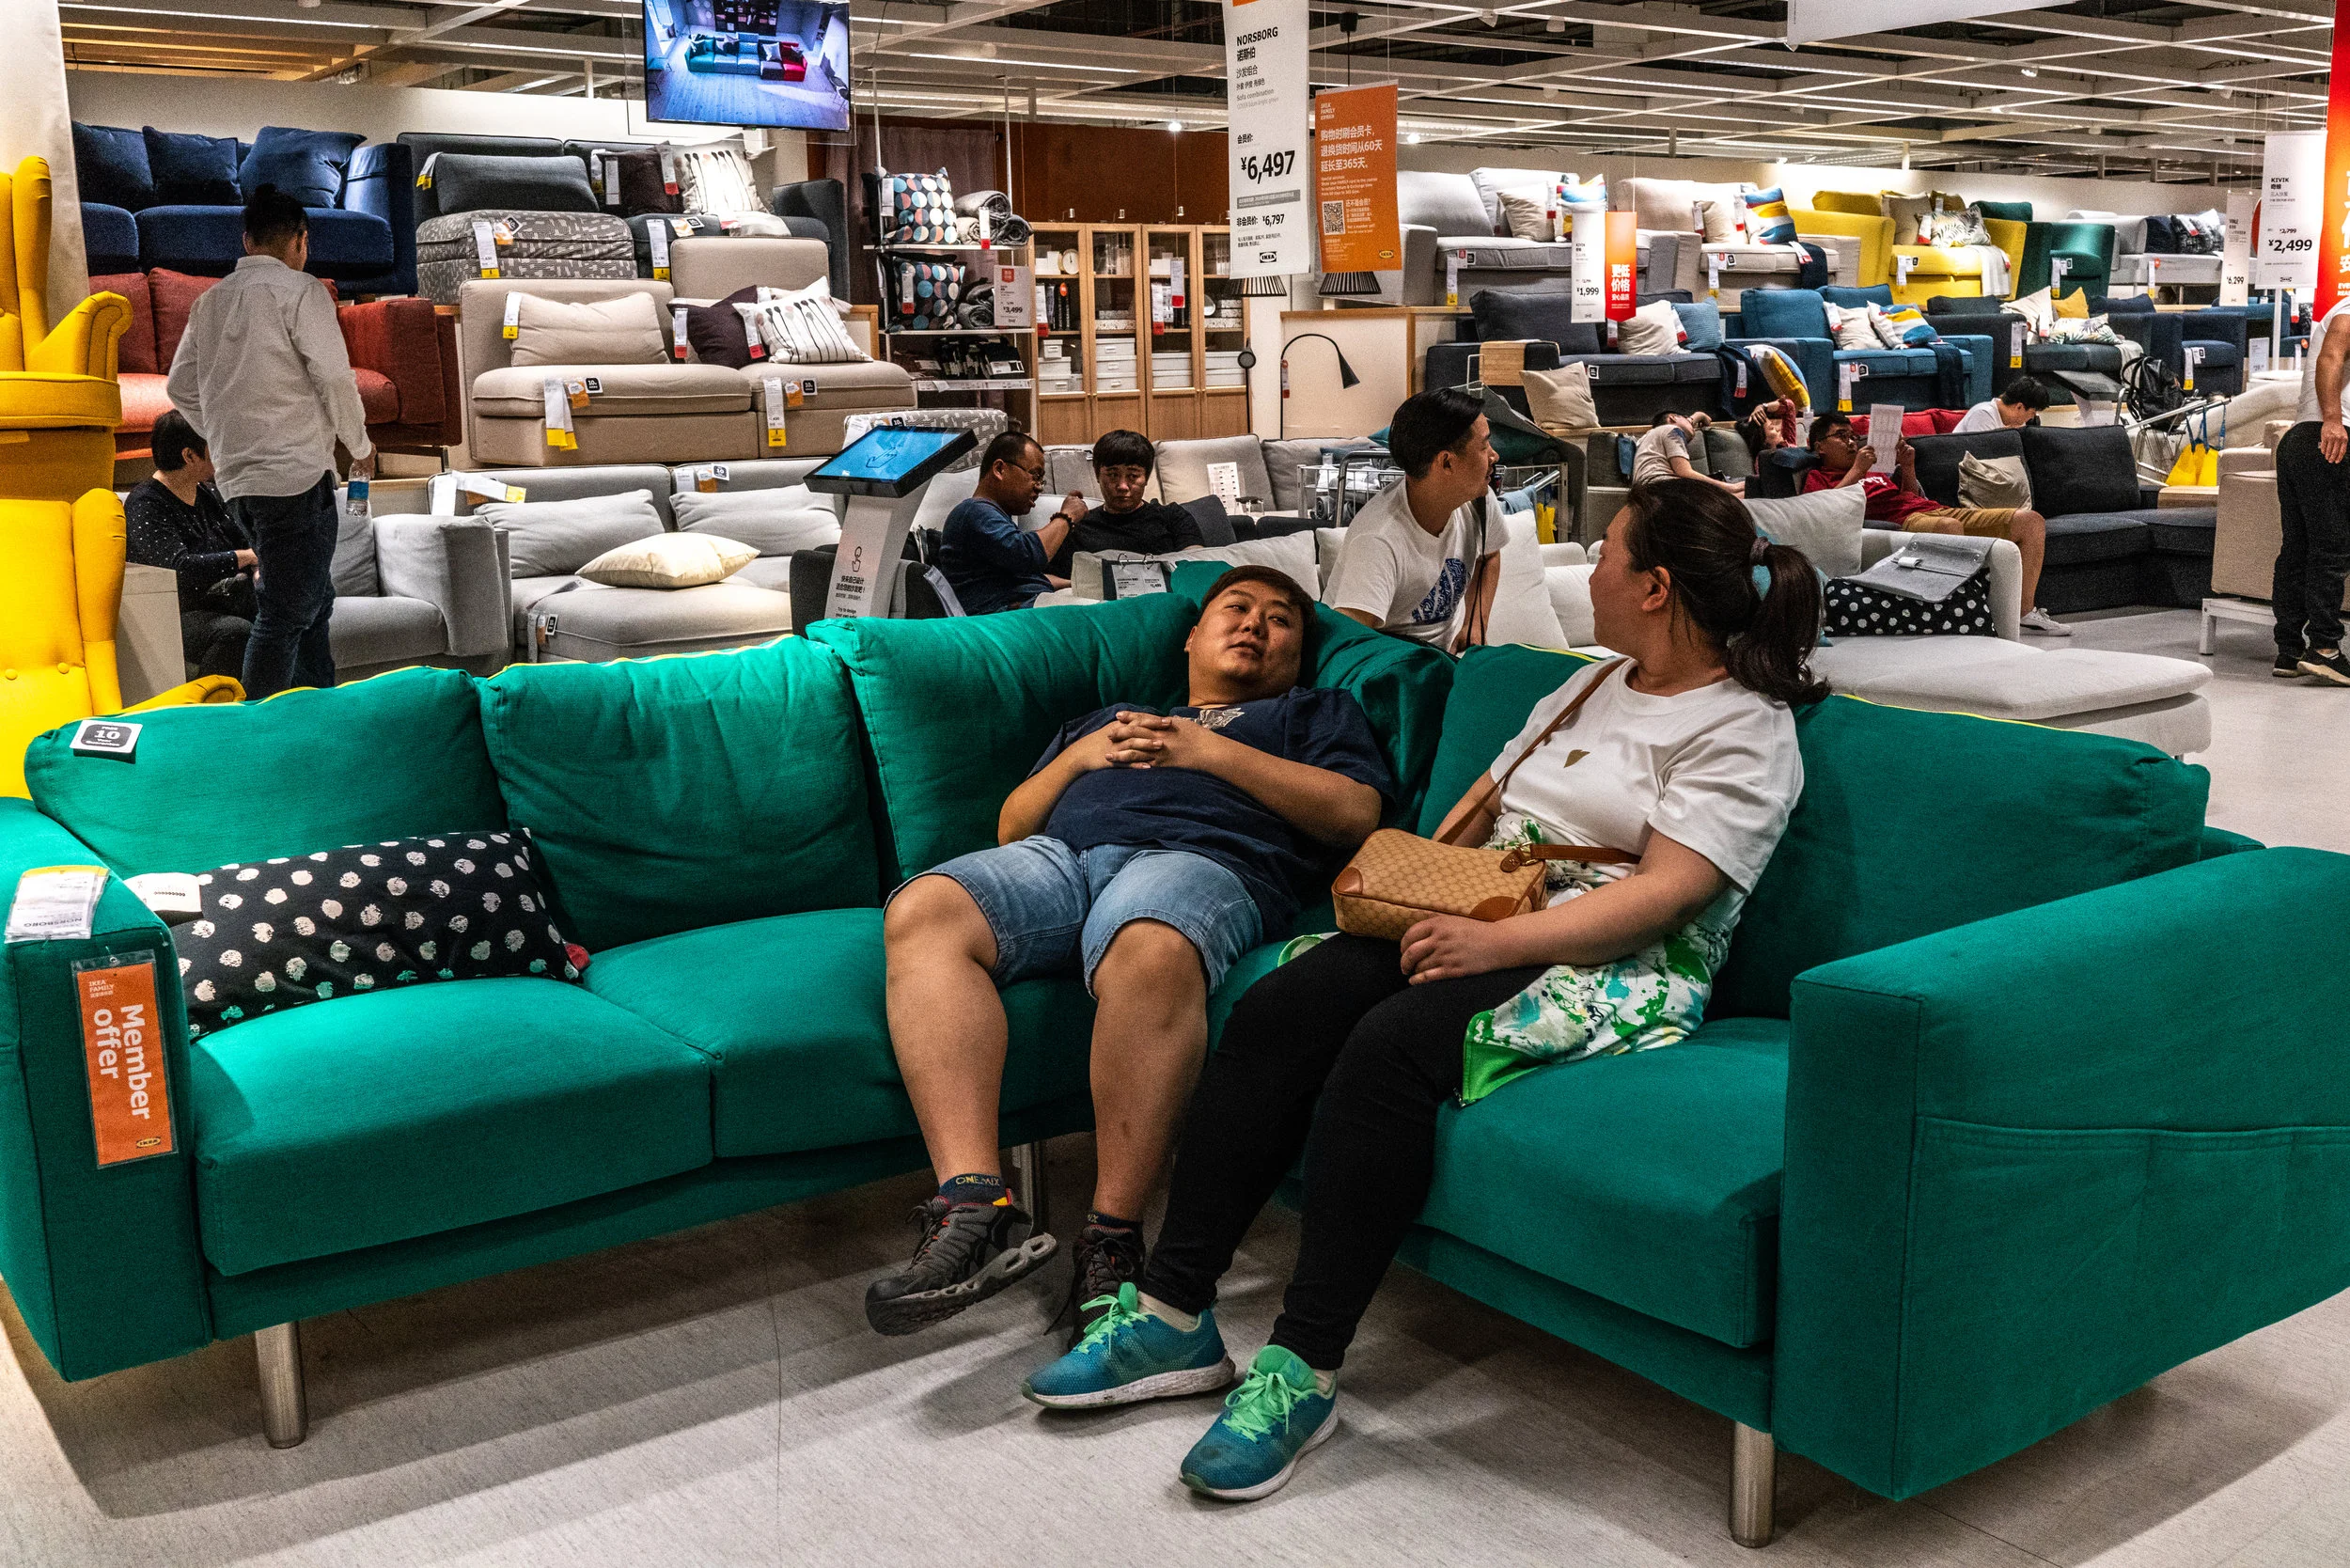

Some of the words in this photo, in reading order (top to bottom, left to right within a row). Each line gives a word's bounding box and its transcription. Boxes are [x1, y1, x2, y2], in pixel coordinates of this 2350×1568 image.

[1236, 26, 1278, 46] NORSBORG
[1237, 46, 1256, 62] 诺斯伯
[1236, 65, 1258, 78] 沙发组合
[1321, 139, 1383, 157] 退换货时间从60天
[1241, 150, 1295, 184] ¥6,497
[1262, 213, 1285, 227] ¥6,797
[2268, 239, 2312, 254] ¥2,499
[1611, 264, 1630, 277] 更低
[1611, 278, 1630, 291] 价格
[1576, 287, 1599, 297] ¥1,999
[94, 729, 120, 739] 10
[24, 917, 82, 928] NORSBORG
[89, 984, 115, 993] FAMILY
[94, 1008, 122, 1080] offer
[120, 1003, 152, 1120] Member
